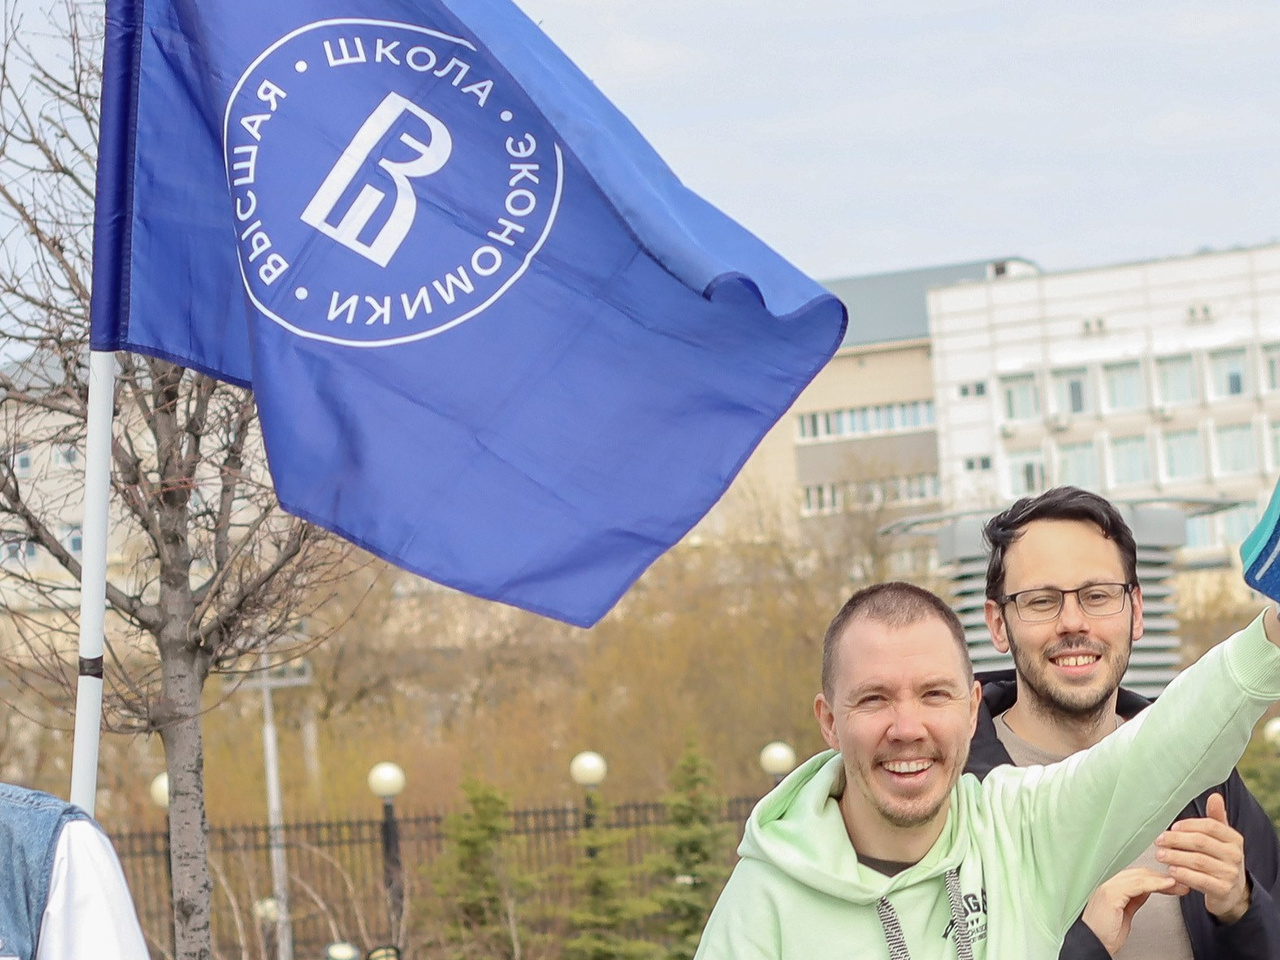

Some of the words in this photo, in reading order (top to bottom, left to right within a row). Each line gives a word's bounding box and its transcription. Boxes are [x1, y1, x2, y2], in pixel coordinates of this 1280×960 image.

[323, 37, 494, 107] ШКОЛА
[233, 79, 289, 286] ВЫСШАЯ
[327, 132, 540, 325] ЭКОНОМИКИ
